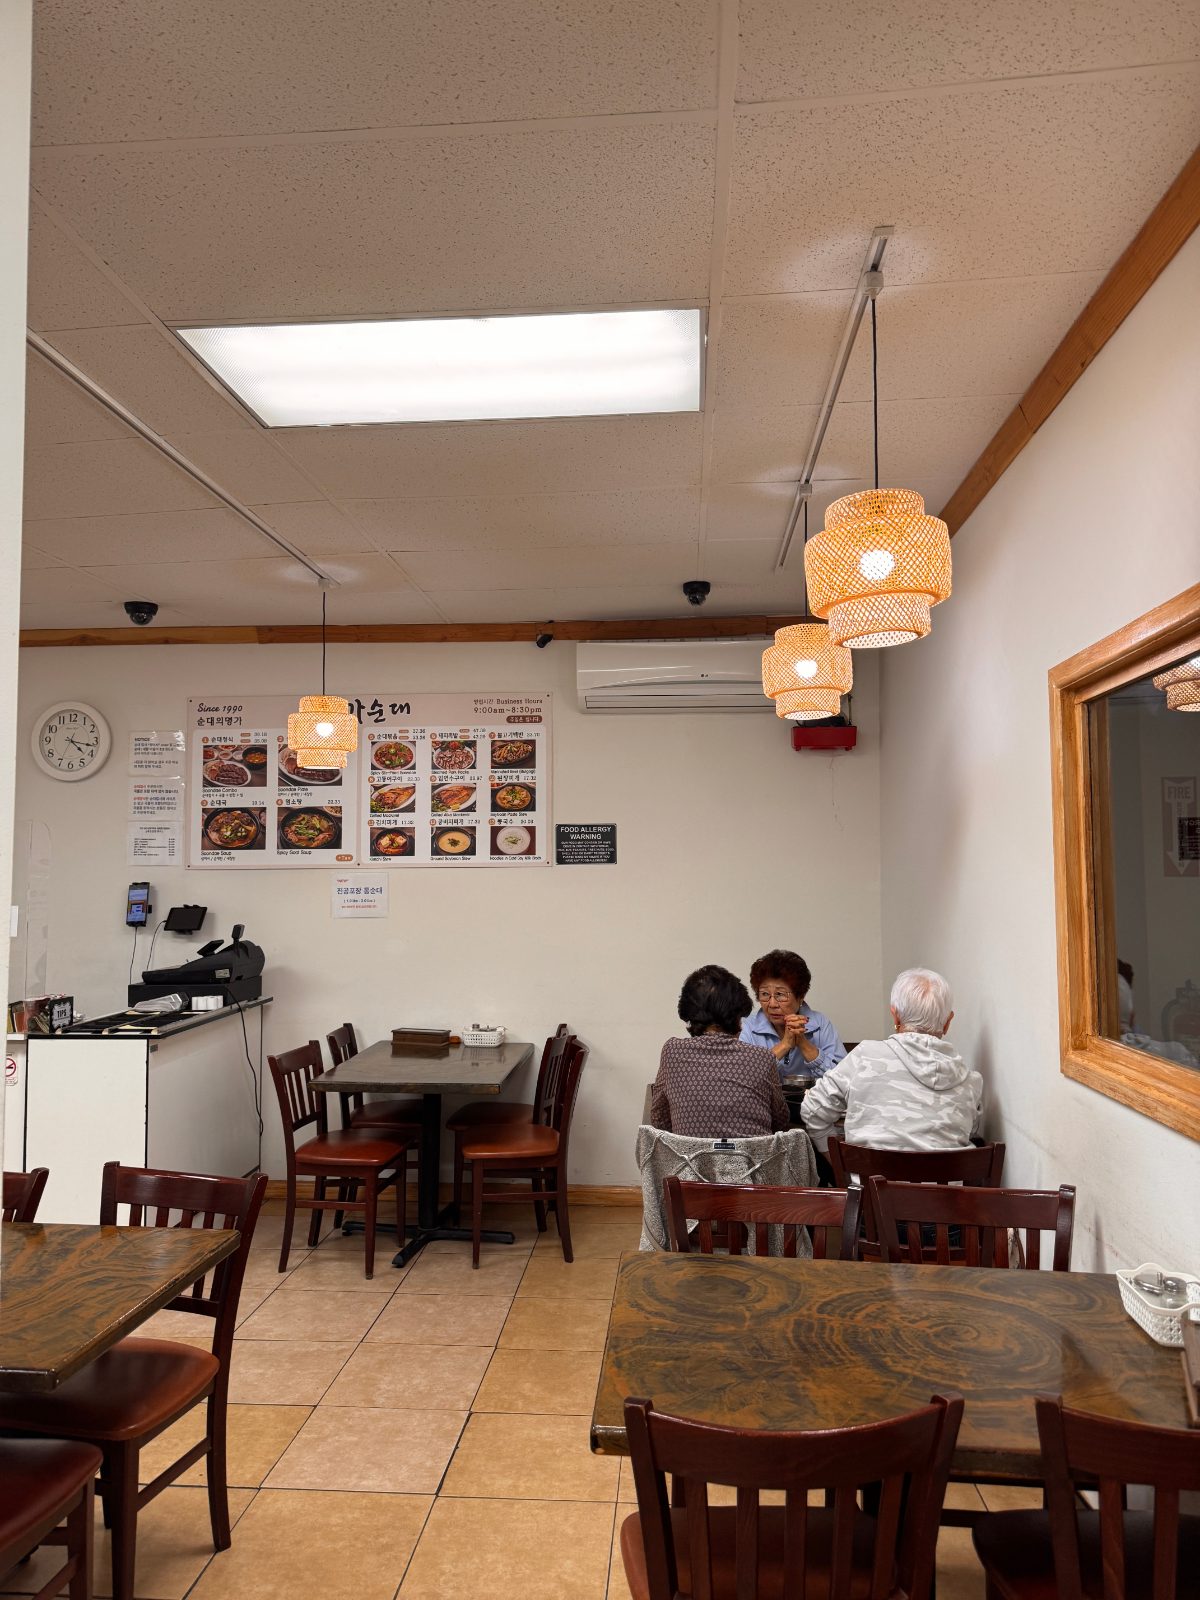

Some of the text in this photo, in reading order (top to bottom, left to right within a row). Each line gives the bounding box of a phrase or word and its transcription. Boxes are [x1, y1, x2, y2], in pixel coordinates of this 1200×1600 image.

[197, 702, 243, 714] Since 1990
[59, 716, 65, 724] 11
[70, 714, 78, 722] 12
[83, 717, 86, 725] 1
[197, 716, 242, 726] 순대의명가
[48, 725, 57, 733] 10
[90, 724, 95, 733] 2
[92, 737, 98, 745] 3
[48, 749, 54, 758] 8
[88, 749, 94, 758] 4
[58, 758, 63, 767] 7
[68, 761, 74, 769] 6
[79, 758, 85, 767] 5
[1168, 786, 1192, 799] FIRE
[57, 1009, 67, 1018] TIPS
